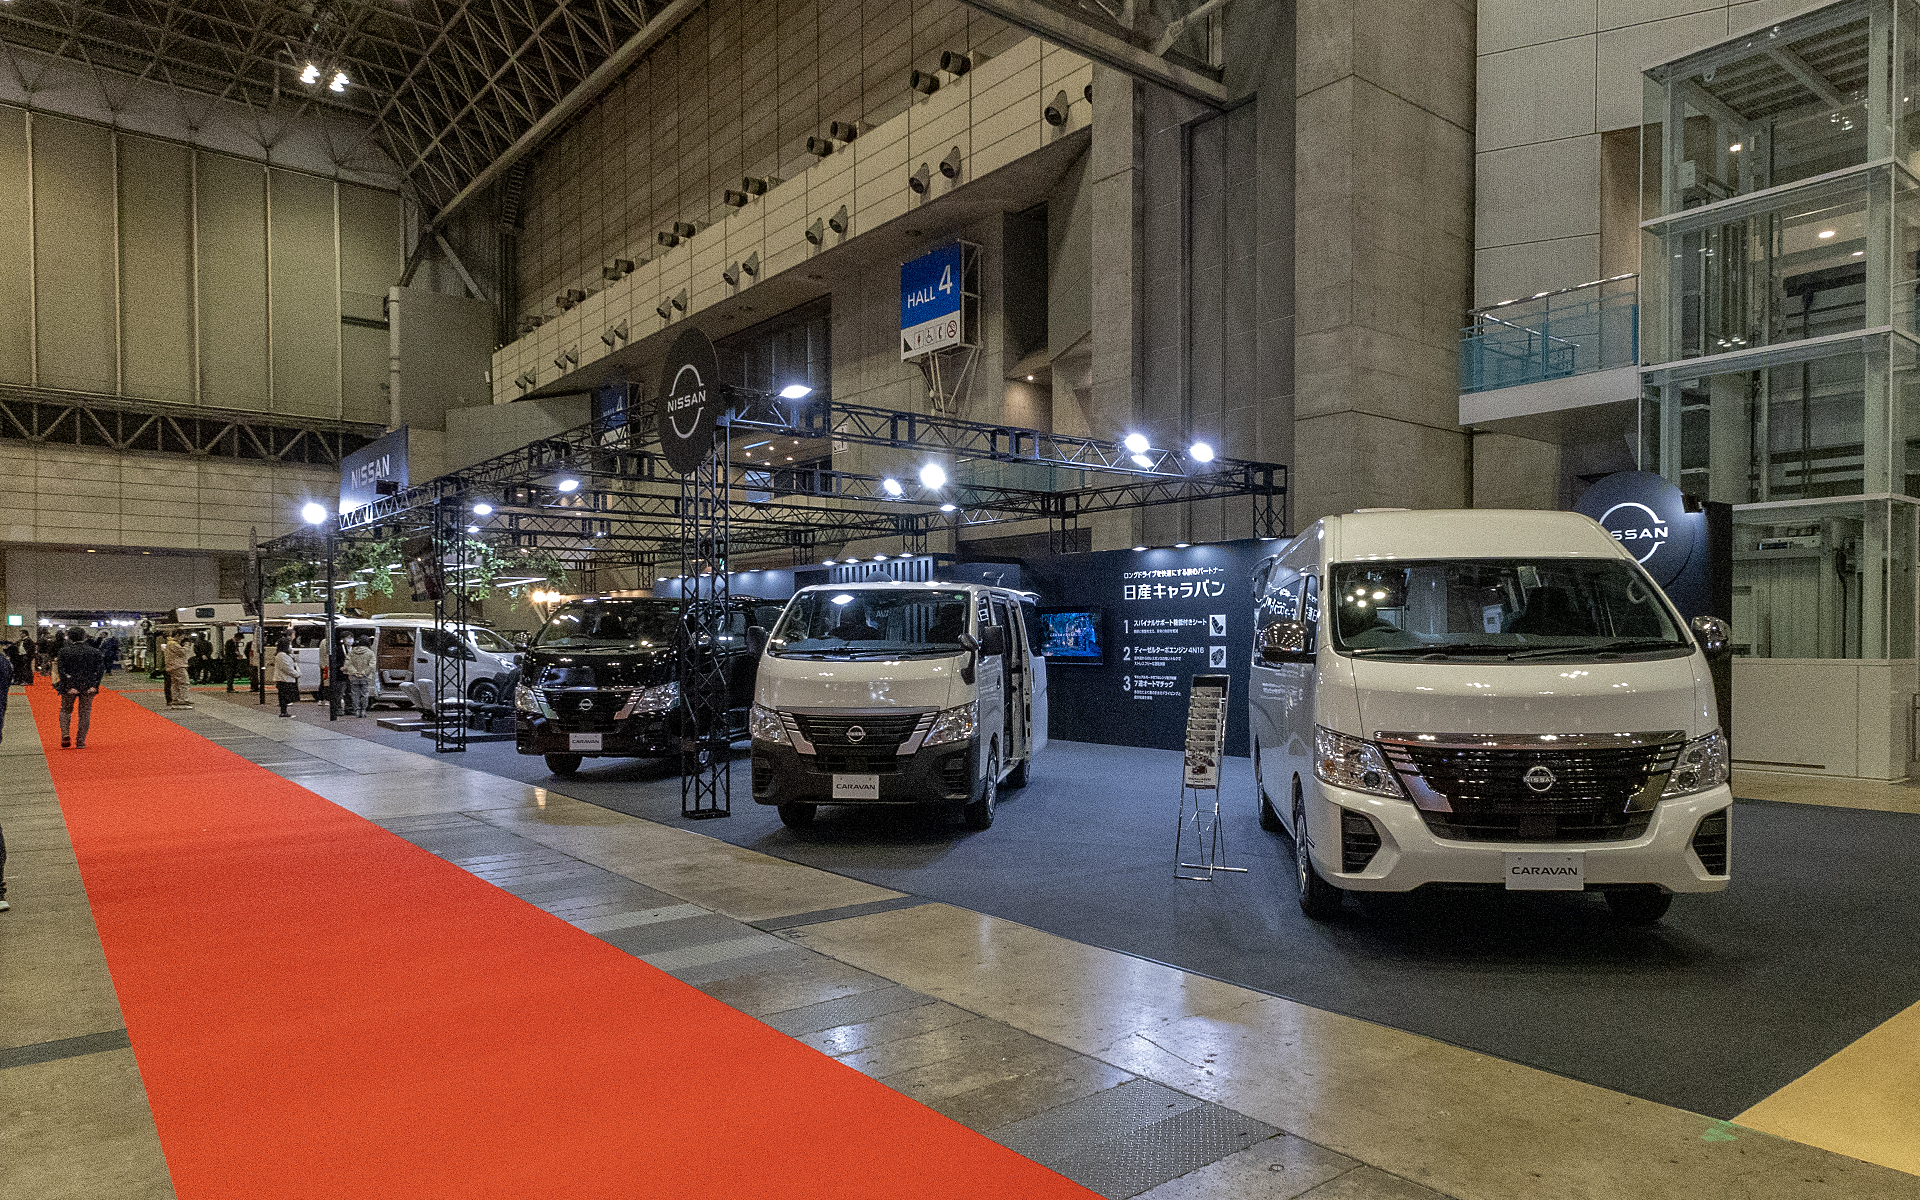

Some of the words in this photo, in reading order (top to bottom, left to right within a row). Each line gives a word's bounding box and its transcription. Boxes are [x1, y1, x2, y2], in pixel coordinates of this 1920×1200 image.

[907, 286, 936, 309] HALL
[938, 264, 953, 295] 4
[667, 389, 706, 413] NISSAN
[351, 453, 390, 491] NISSAN
[1610, 526, 1669, 541] SSAN
[1124, 578, 1226, 600] 日産キャラバン
[1123, 619, 1129, 634] 1
[1123, 646, 1131, 661] 2
[1123, 675, 1131, 691] 3
[1523, 775, 1557, 783] NISSAN
[1511, 866, 1578, 876] CARAVAN
